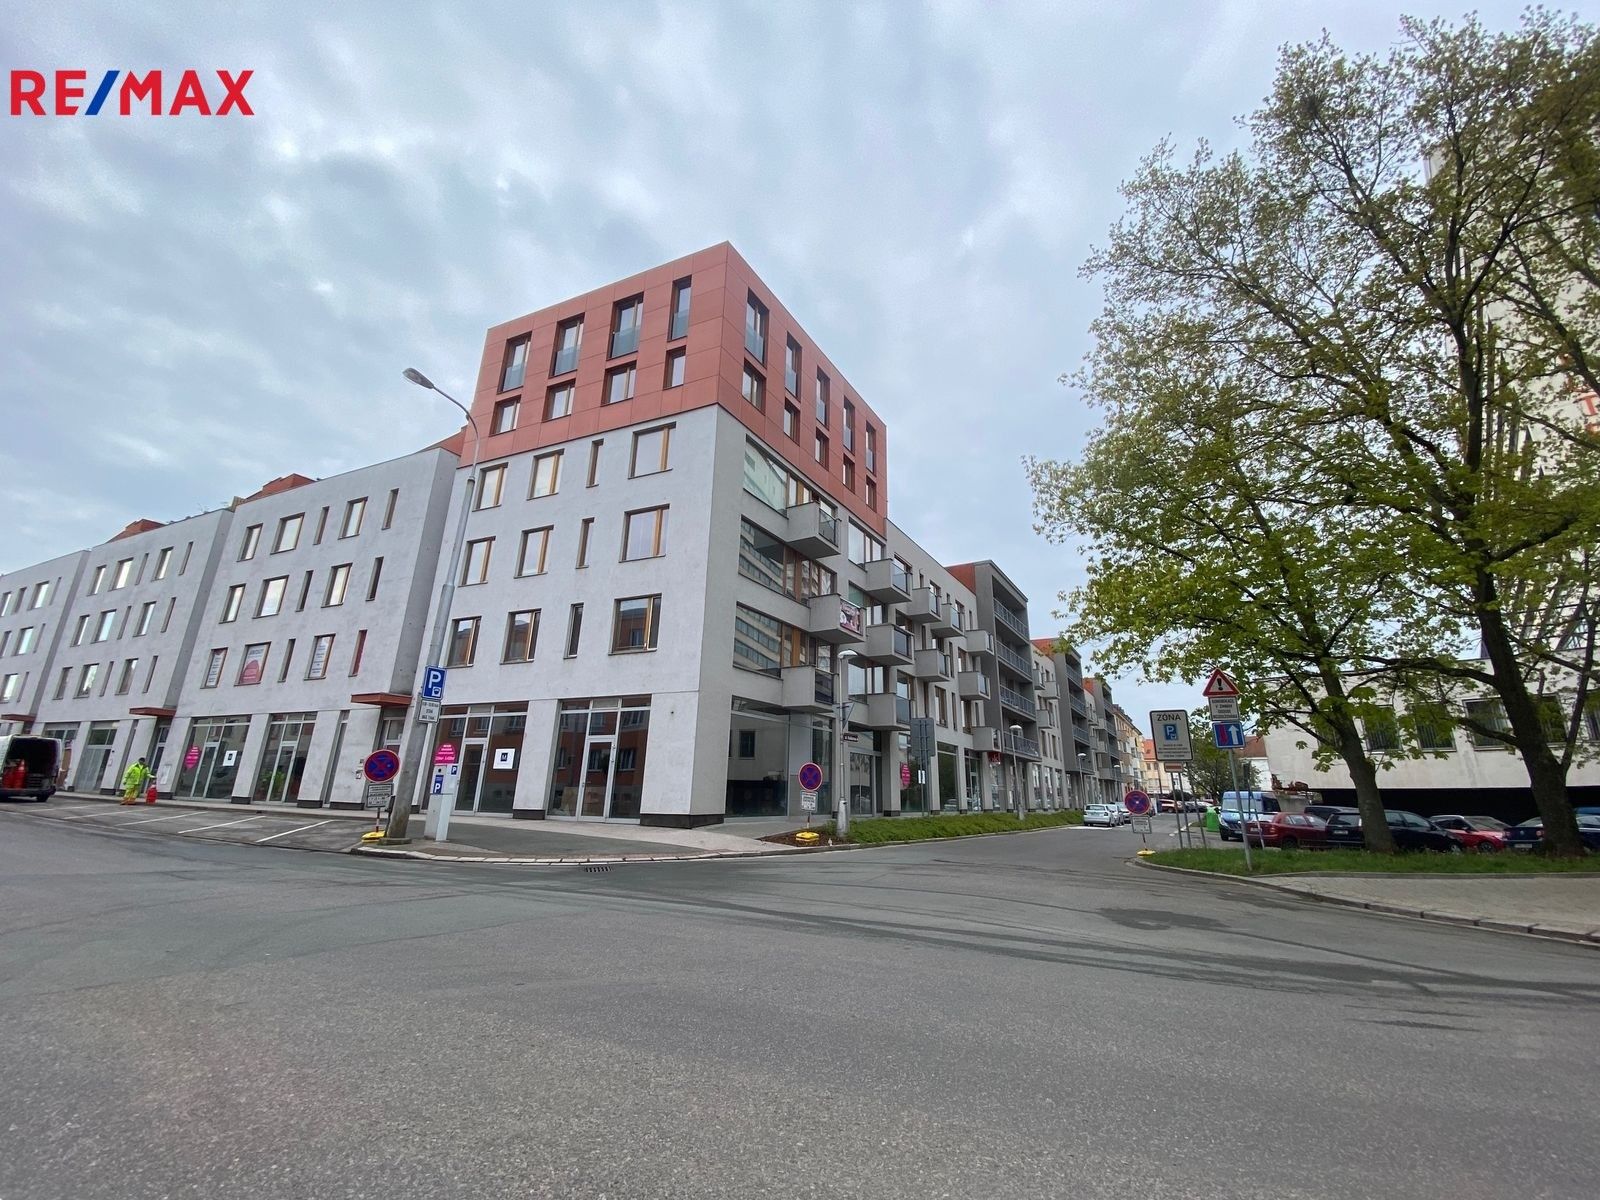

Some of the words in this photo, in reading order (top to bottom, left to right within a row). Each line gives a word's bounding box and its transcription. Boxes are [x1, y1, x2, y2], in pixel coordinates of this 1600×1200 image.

[428, 670, 442, 688] P
[1166, 726, 1174, 736] P
[434, 783, 441, 793] P
